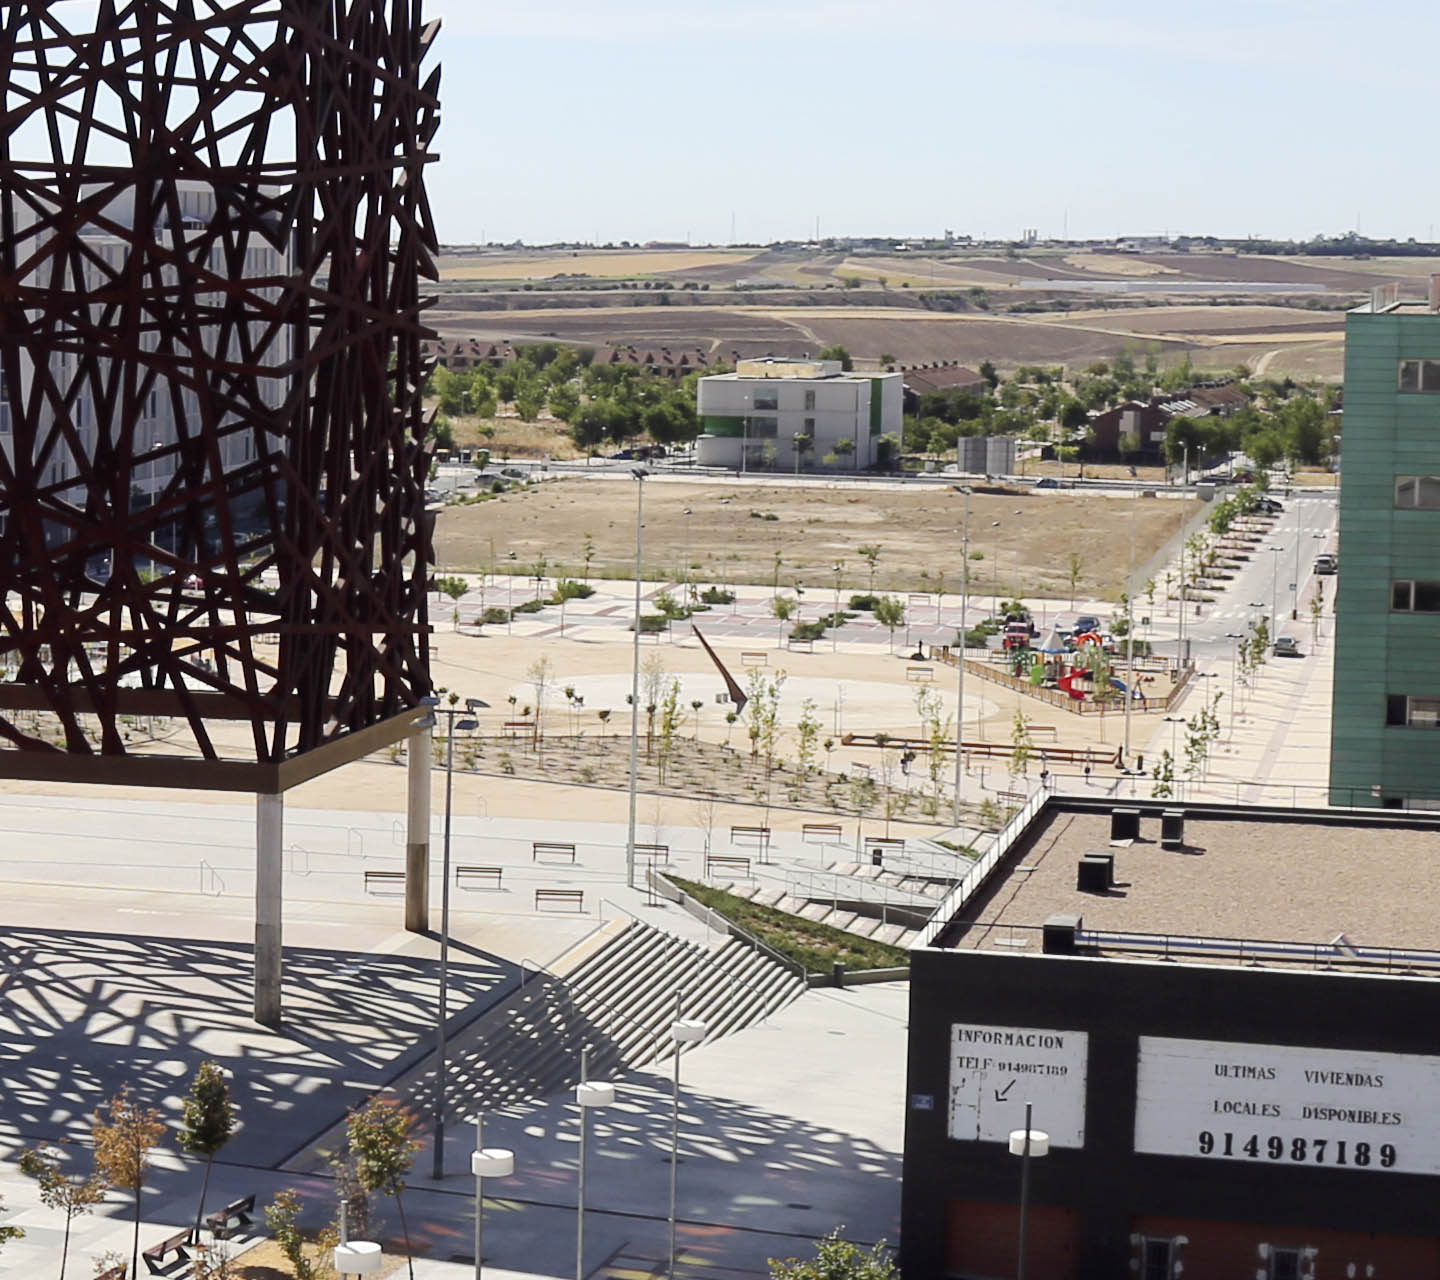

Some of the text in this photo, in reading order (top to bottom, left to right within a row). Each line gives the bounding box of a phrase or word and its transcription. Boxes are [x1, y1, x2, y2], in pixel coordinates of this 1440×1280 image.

[958, 1029, 1064, 1048] INFORMACION
[1214, 1064, 1384, 1088] ULTIMAS VIVIENDAS
[1213, 1100, 1402, 1125] LOCALES DISPONIBLES
[1199, 1131, 1396, 1168] 914987189
